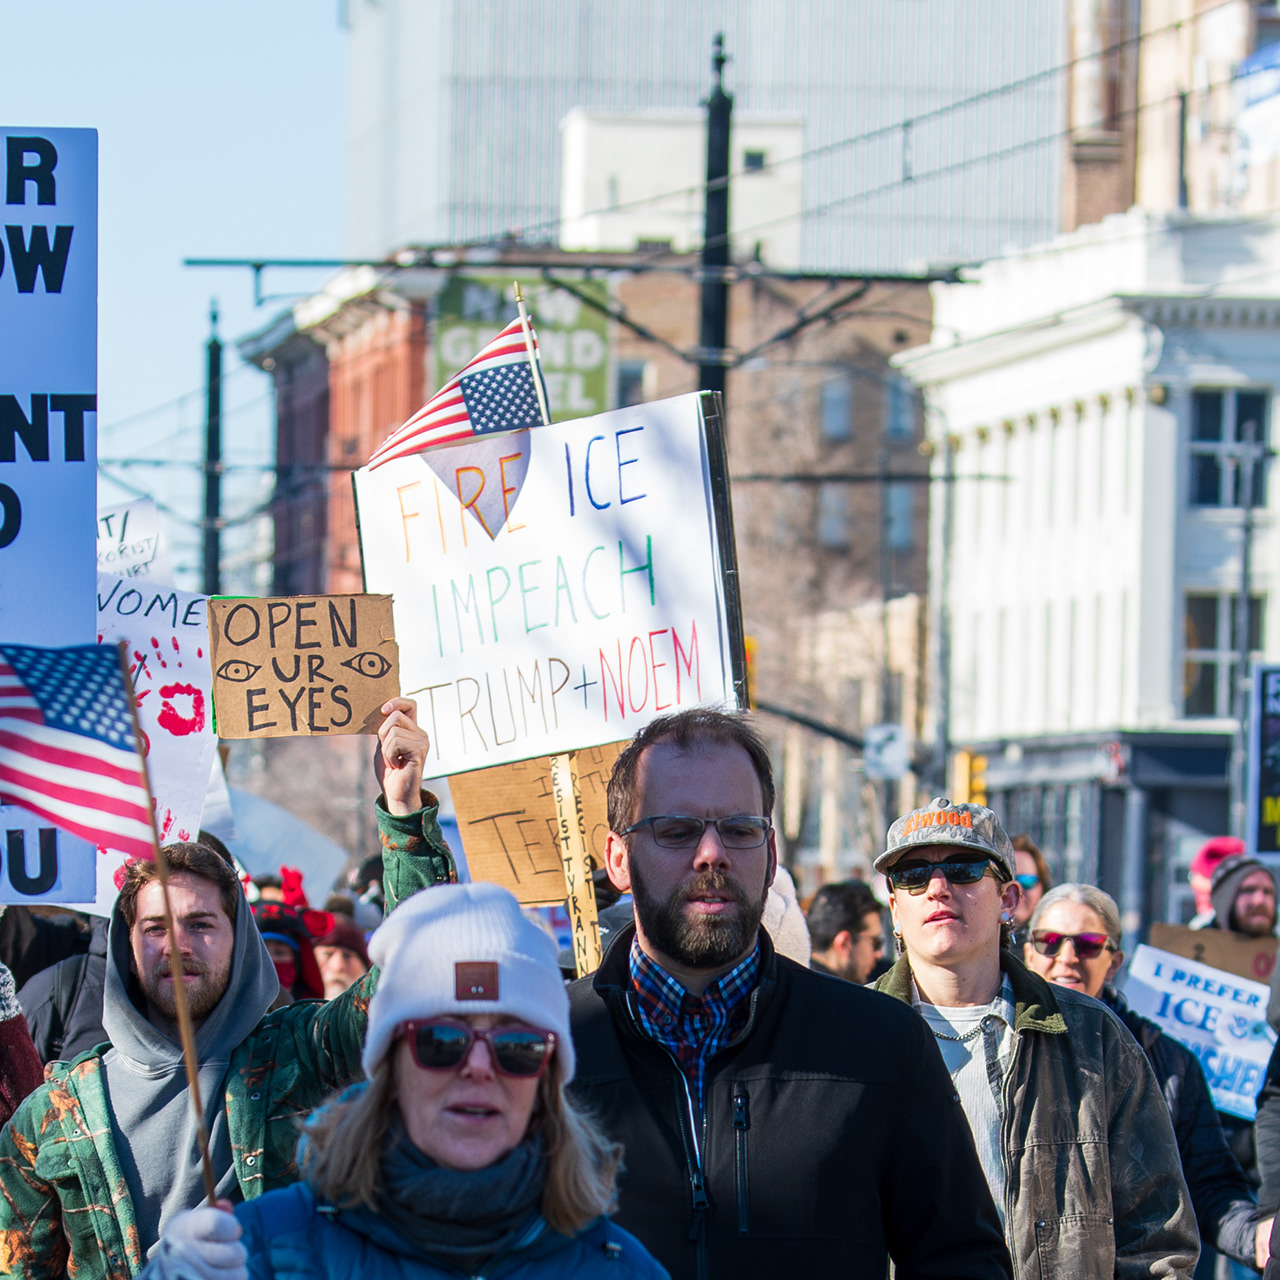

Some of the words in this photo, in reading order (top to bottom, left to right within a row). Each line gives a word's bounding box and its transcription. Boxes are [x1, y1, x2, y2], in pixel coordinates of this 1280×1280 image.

[397, 452, 527, 563] FIRE
[565, 426, 647, 517] ICE
[432, 534, 656, 658] IMPEACH
[224, 599, 358, 650] OPEN
[271, 654, 334, 684] UR
[246, 684, 353, 733] EYES
[1154, 962, 1162, 978] I
[1171, 968, 1262, 1008] PREFER
[1156, 991, 1222, 1032] ICE
